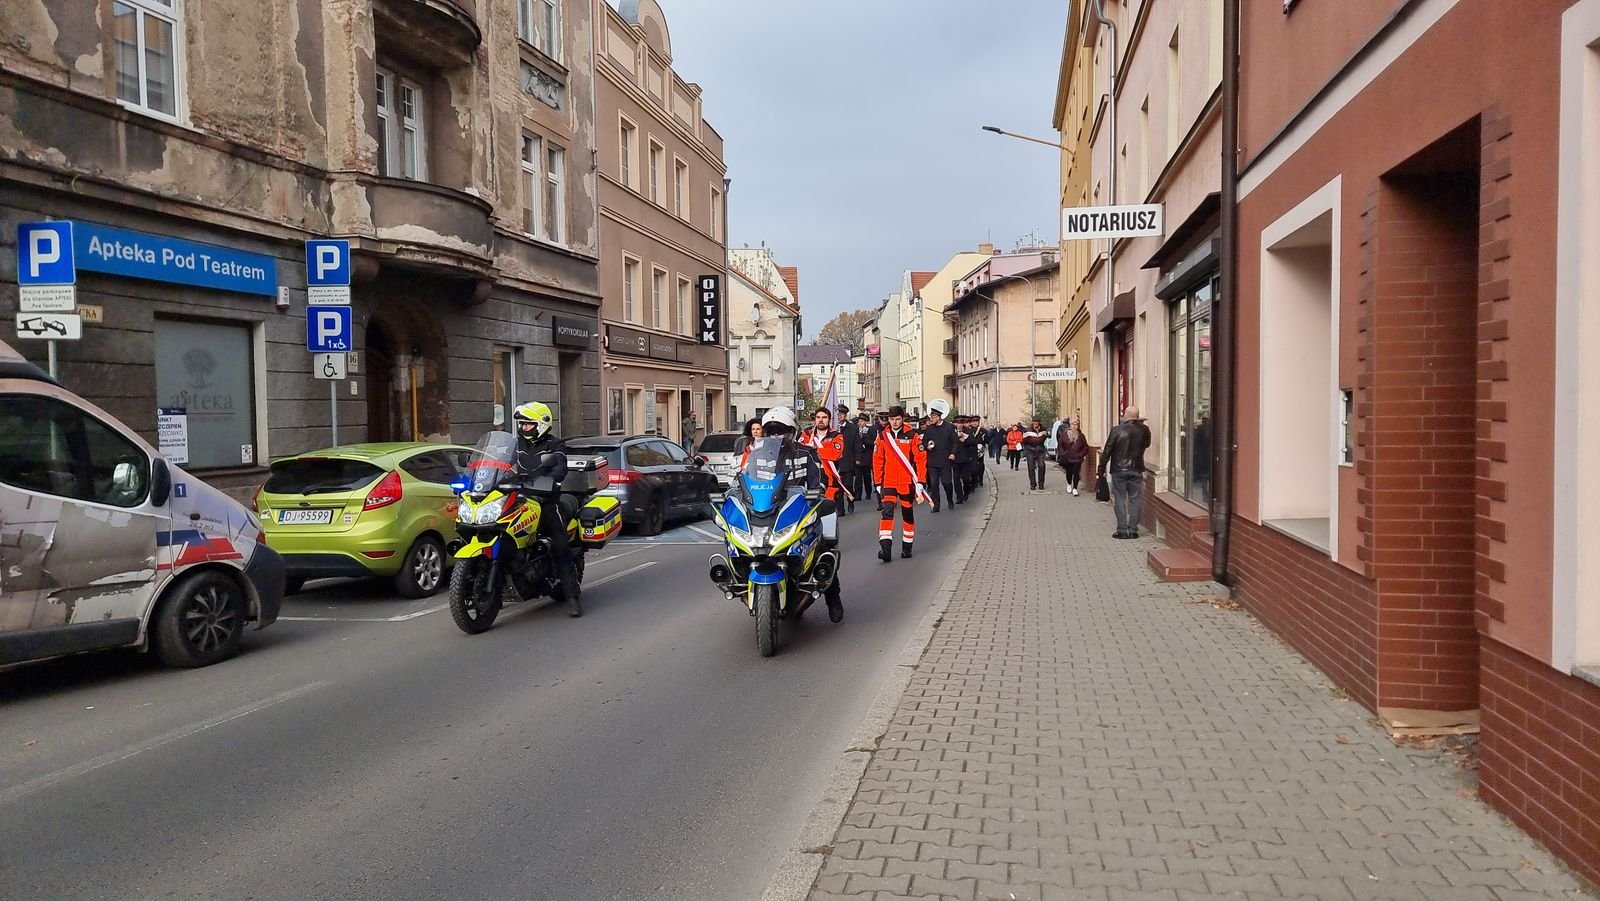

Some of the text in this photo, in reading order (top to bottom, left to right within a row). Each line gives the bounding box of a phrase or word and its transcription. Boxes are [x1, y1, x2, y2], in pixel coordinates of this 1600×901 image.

[1068, 211, 1156, 233] NOTARIUSZ
[29, 230, 60, 277] P
[88, 235, 265, 280] Apteka Pod Teatrem
[316, 245, 340, 280] P
[703, 278, 715, 342] OPTYK
[317, 311, 342, 346] P
[1038, 370, 1075, 378] NOTARIUSZ
[170, 390, 234, 410] apteka
[158, 422, 182, 430] ZCZEPIEŃ
[177, 485, 183, 496] 1
[285, 510, 297, 521] DJ
[300, 510, 330, 521] 95599
